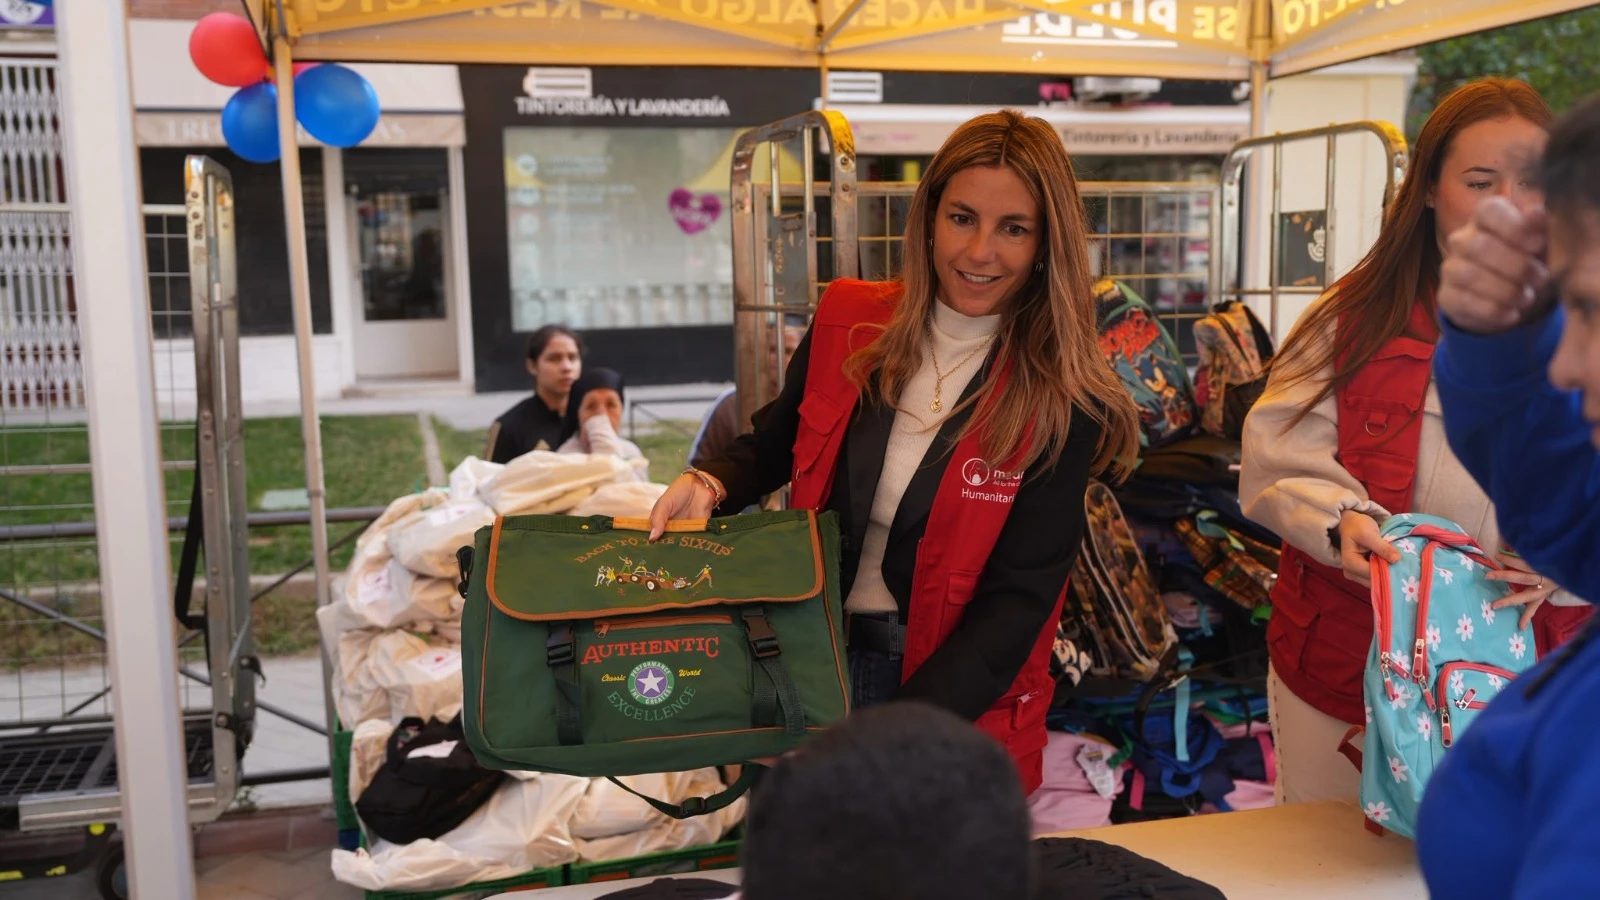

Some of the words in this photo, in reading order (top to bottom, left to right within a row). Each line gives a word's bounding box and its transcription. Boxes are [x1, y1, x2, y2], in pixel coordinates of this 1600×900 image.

[574, 543, 615, 563] BACK
[616, 537, 638, 547] TO
[581, 636, 719, 665] AUTHENTIC
[601, 673, 626, 682] Classic
[678, 669, 702, 677] World
[630, 661, 671, 677] PERFORMANCE
[607, 686, 696, 722] EXCELLENCE
[630, 689, 641, 699] THE
